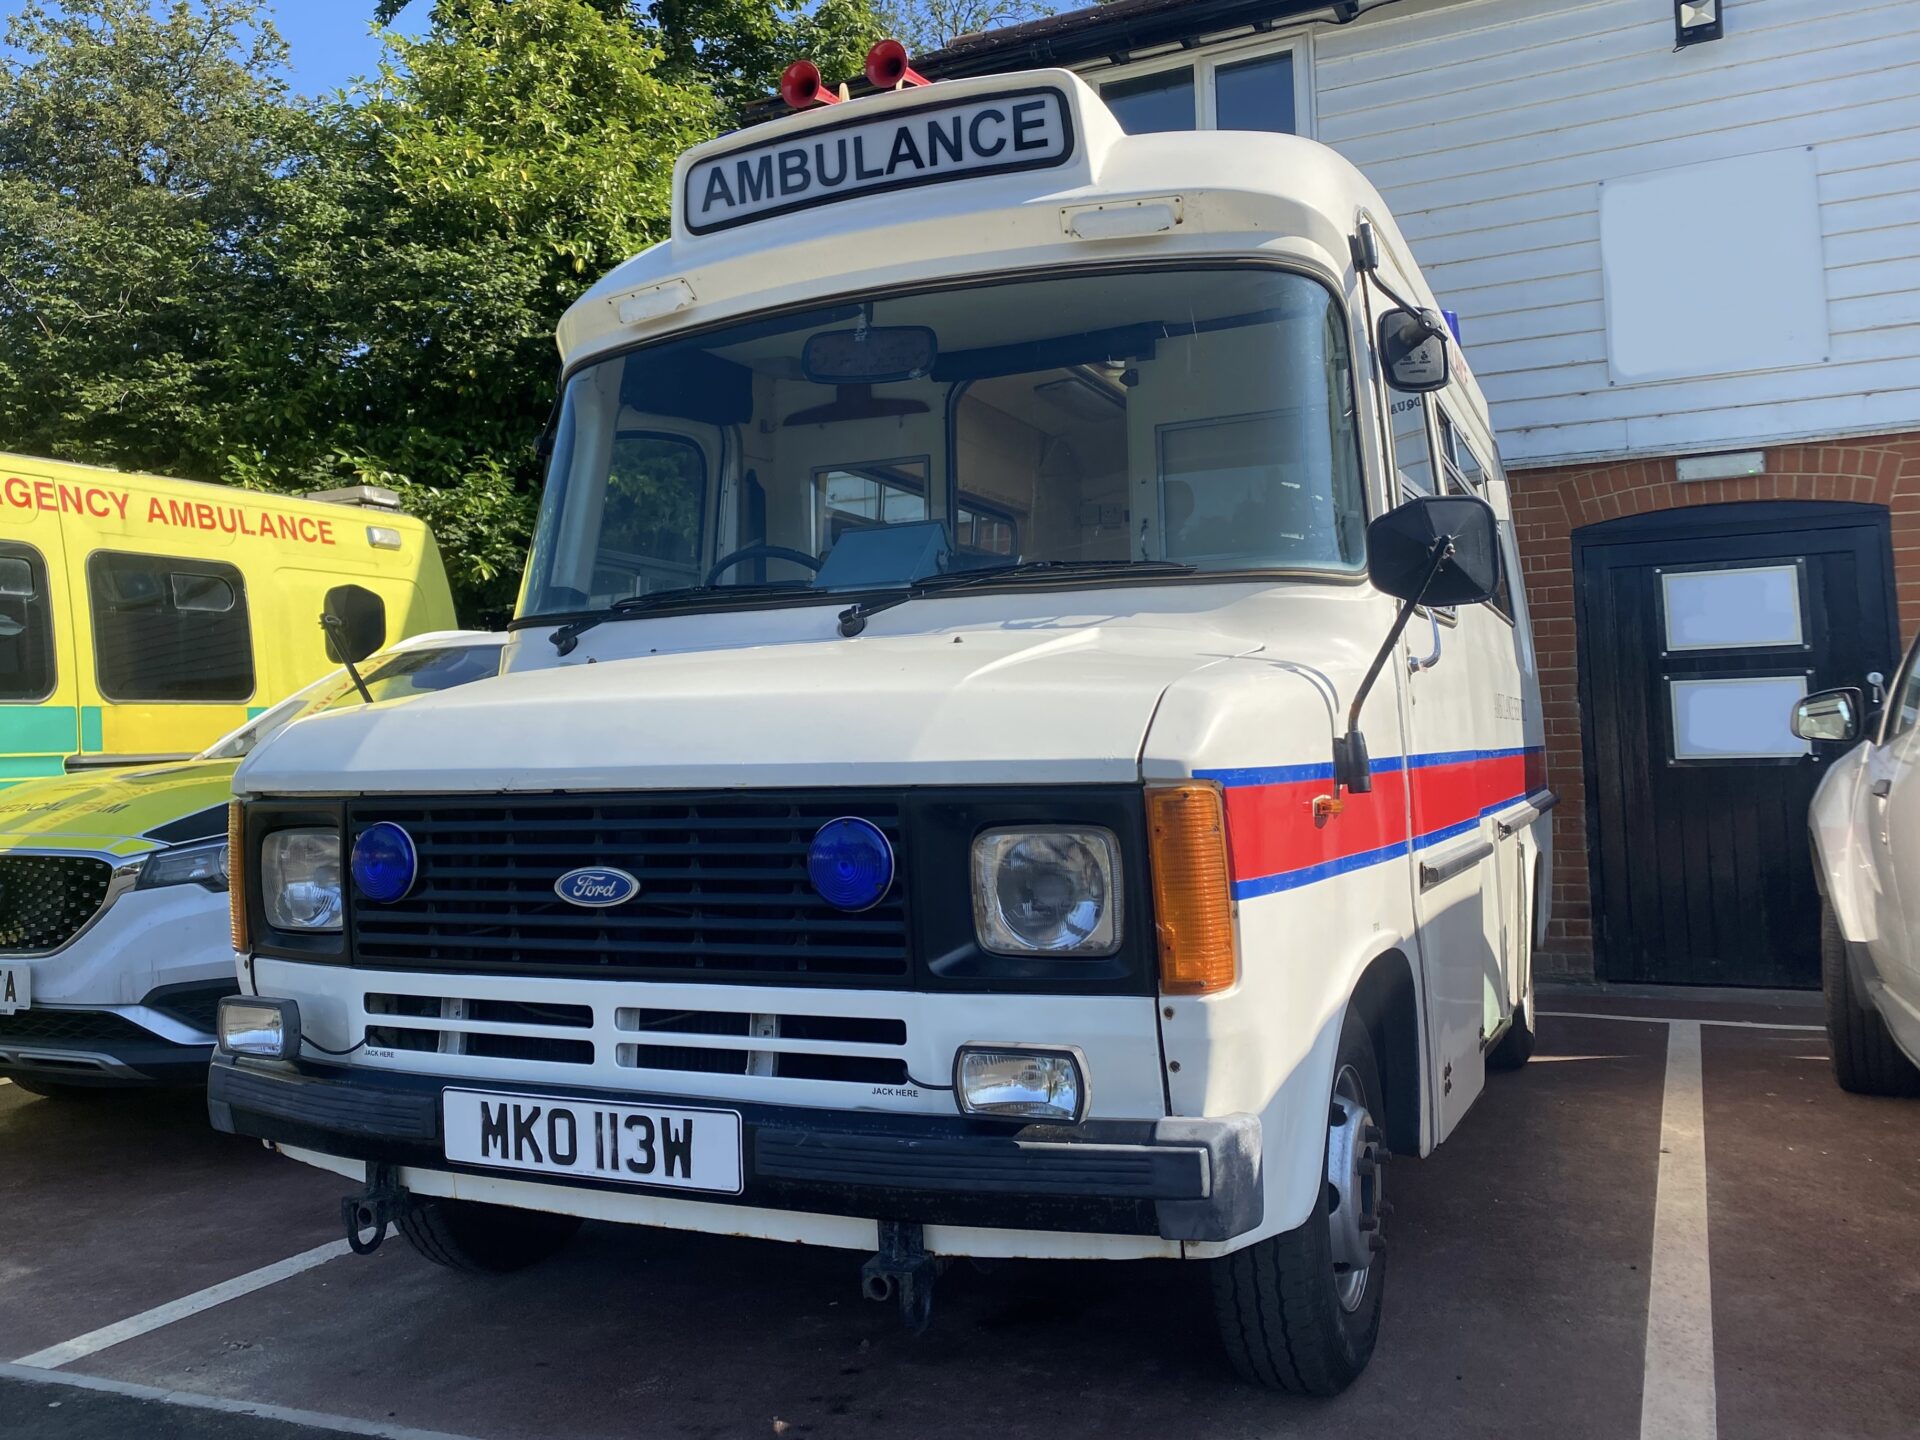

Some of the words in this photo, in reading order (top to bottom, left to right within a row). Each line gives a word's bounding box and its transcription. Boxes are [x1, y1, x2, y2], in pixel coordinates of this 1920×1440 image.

[701, 100, 1049, 212] AMBULANCE
[0, 477, 129, 520] GENCY
[147, 497, 336, 546] AMBULANCE
[573, 875, 617, 897] Ford
[0, 970, 17, 1003] A
[364, 1049, 379, 1057] JACK
[872, 1087, 894, 1096] JACK
[895, 1089, 919, 1098] HERE
[480, 1101, 577, 1166] MKO
[594, 1112, 693, 1179] 113W
